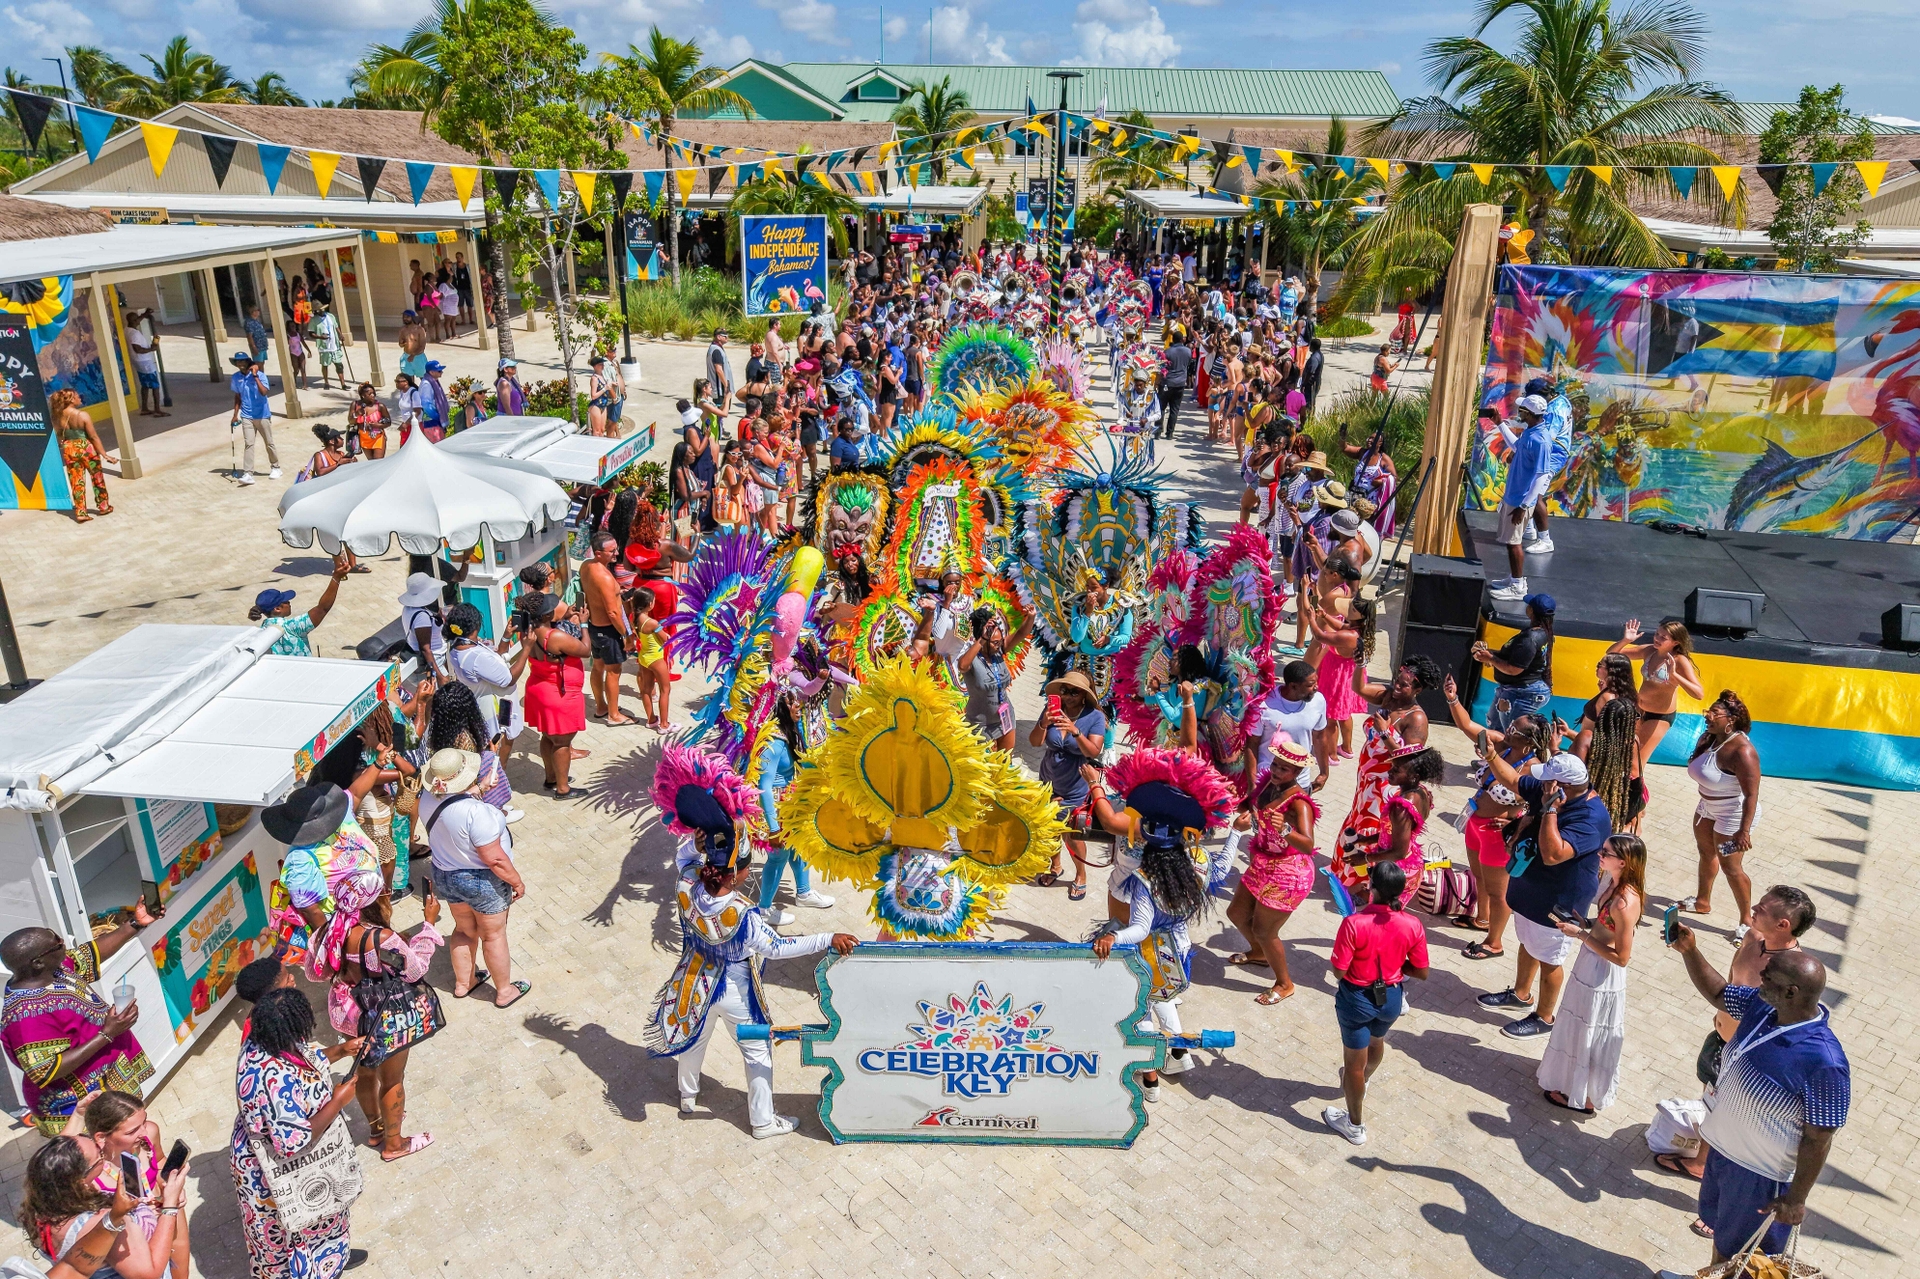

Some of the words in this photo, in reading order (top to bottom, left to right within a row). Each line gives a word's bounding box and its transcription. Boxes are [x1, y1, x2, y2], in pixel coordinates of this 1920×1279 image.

[627, 216, 652, 228] HAPPY
[762, 224, 807, 243] Happy
[749, 242, 820, 259] INDEPENDENCE
[768, 257, 817, 275] Bahamas!
[328, 708, 352, 745] Sweet
[188, 883, 235, 953] Sweet
[200, 917, 234, 960] TINGS
[383, 993, 433, 1034] CRUISE
[859, 1051, 1099, 1078] CELEBRATION
[946, 1073, 1016, 1098] KEY
[945, 1115, 1037, 1129] Carnival
[271, 1141, 335, 1179] BAHAMAS
[319, 1146, 347, 1170] original
